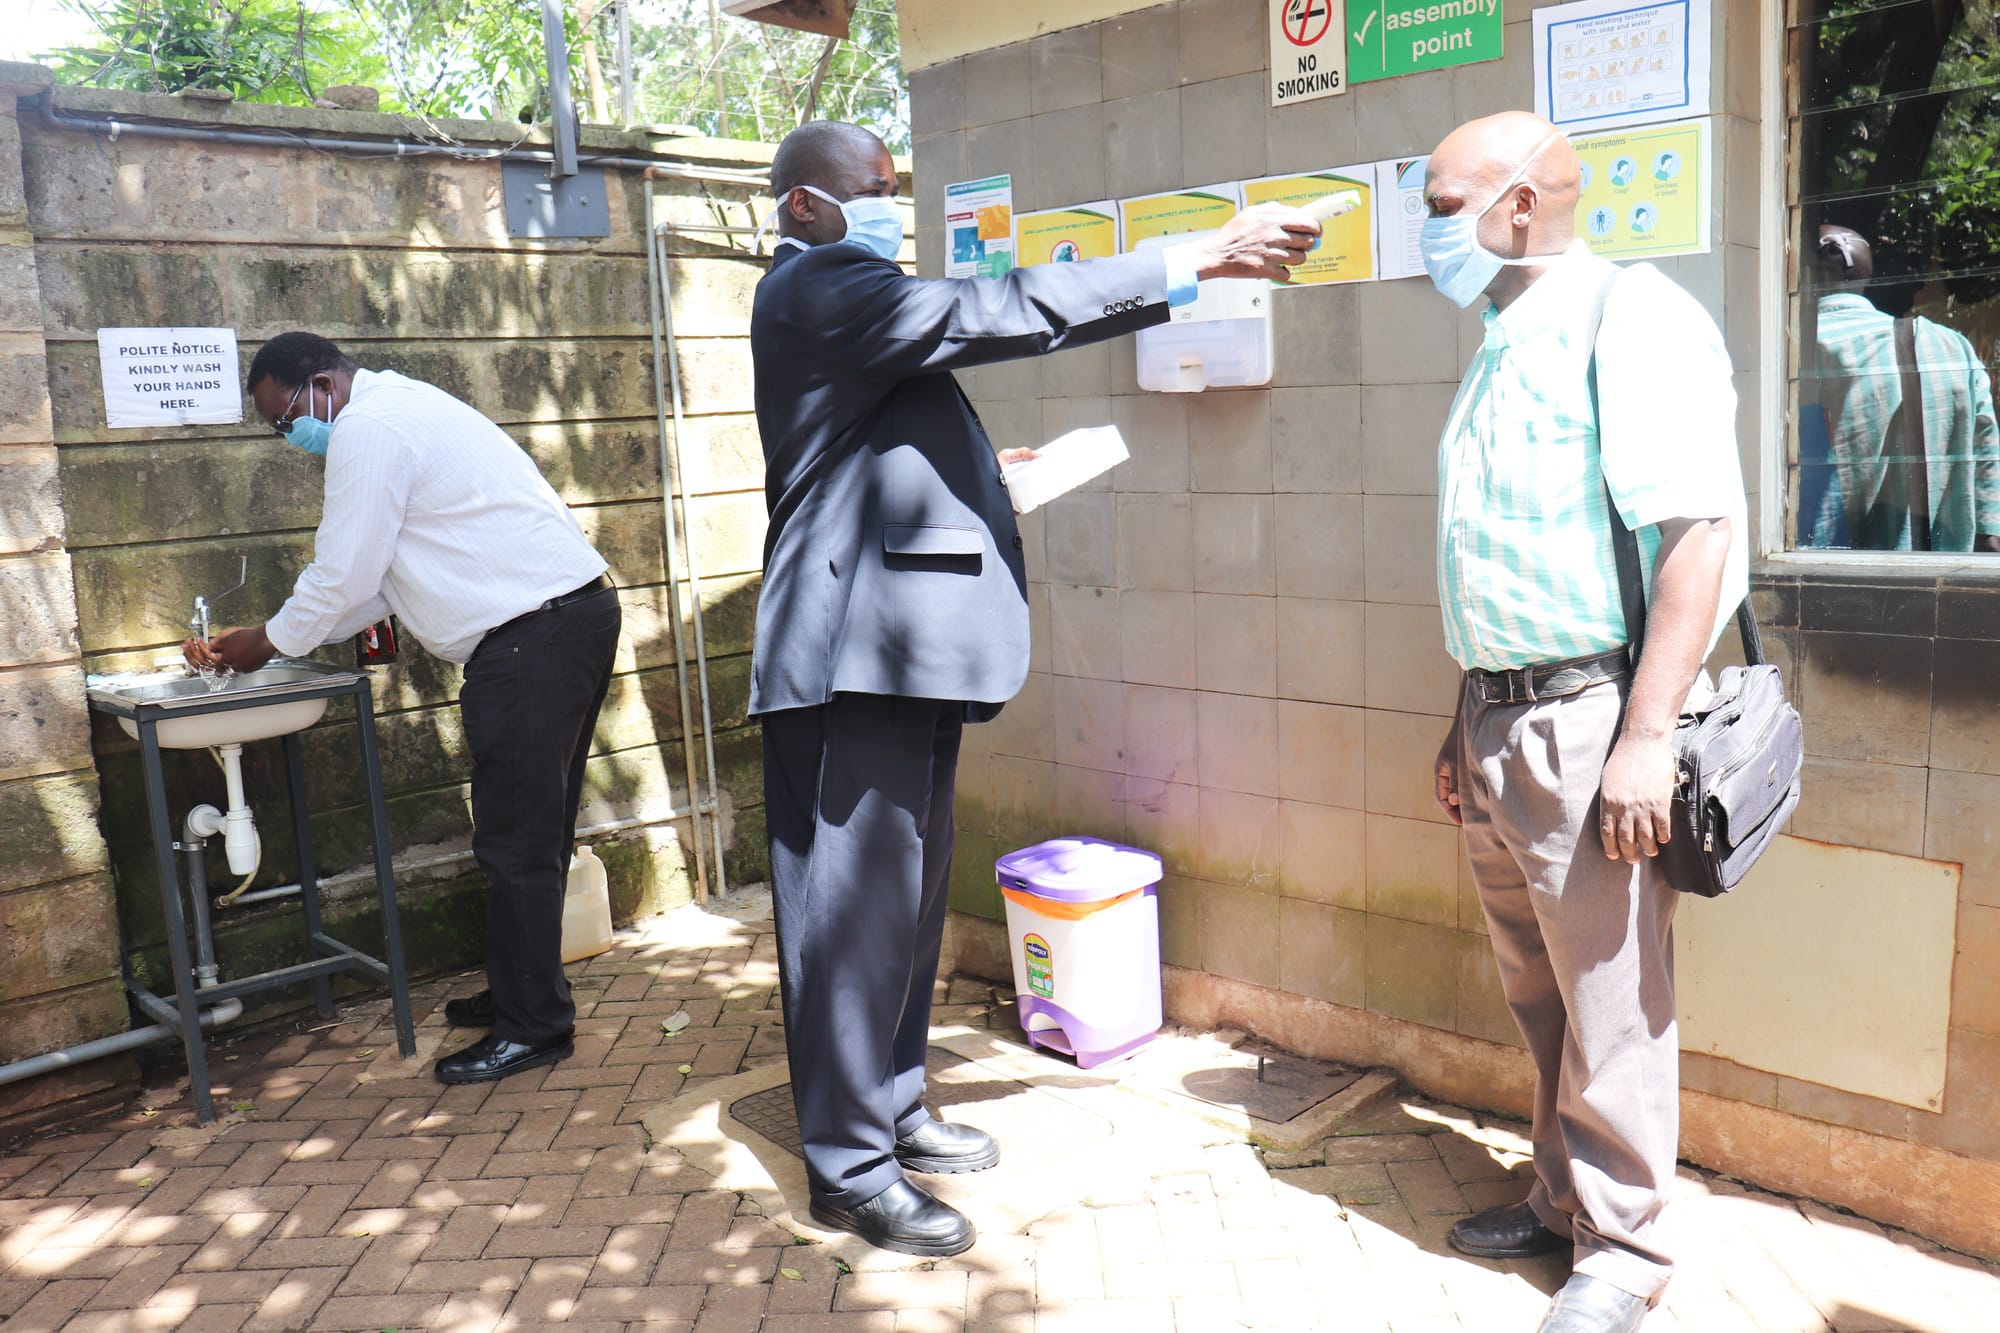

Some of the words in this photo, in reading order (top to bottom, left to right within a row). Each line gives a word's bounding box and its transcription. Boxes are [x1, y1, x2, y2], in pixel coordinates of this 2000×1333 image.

[1386, 0, 1498, 31] assembly
[1576, 20, 1594, 30] Hand
[1595, 14, 1623, 26] washing
[1624, 9, 1659, 21] technique
[1582, 28, 1598, 36] with
[1599, 24, 1615, 34] soap
[1616, 22, 1630, 31] and
[1631, 20, 1651, 28] water
[1412, 27, 1473, 62] point
[1298, 54, 1317, 73] NO
[1277, 70, 1339, 99] SMOKING
[1576, 140, 1588, 151] and
[1590, 138, 1626, 150] symptoms
[120, 346, 168, 356] POLITE
[172, 344, 225, 355] NOTICE.
[128, 364, 178, 375] KINDLY
[182, 362, 221, 373] WASH
[133, 382, 172, 392] YOUR
[176, 380, 221, 391] HANDS
[160, 399, 200, 409] HERE.
